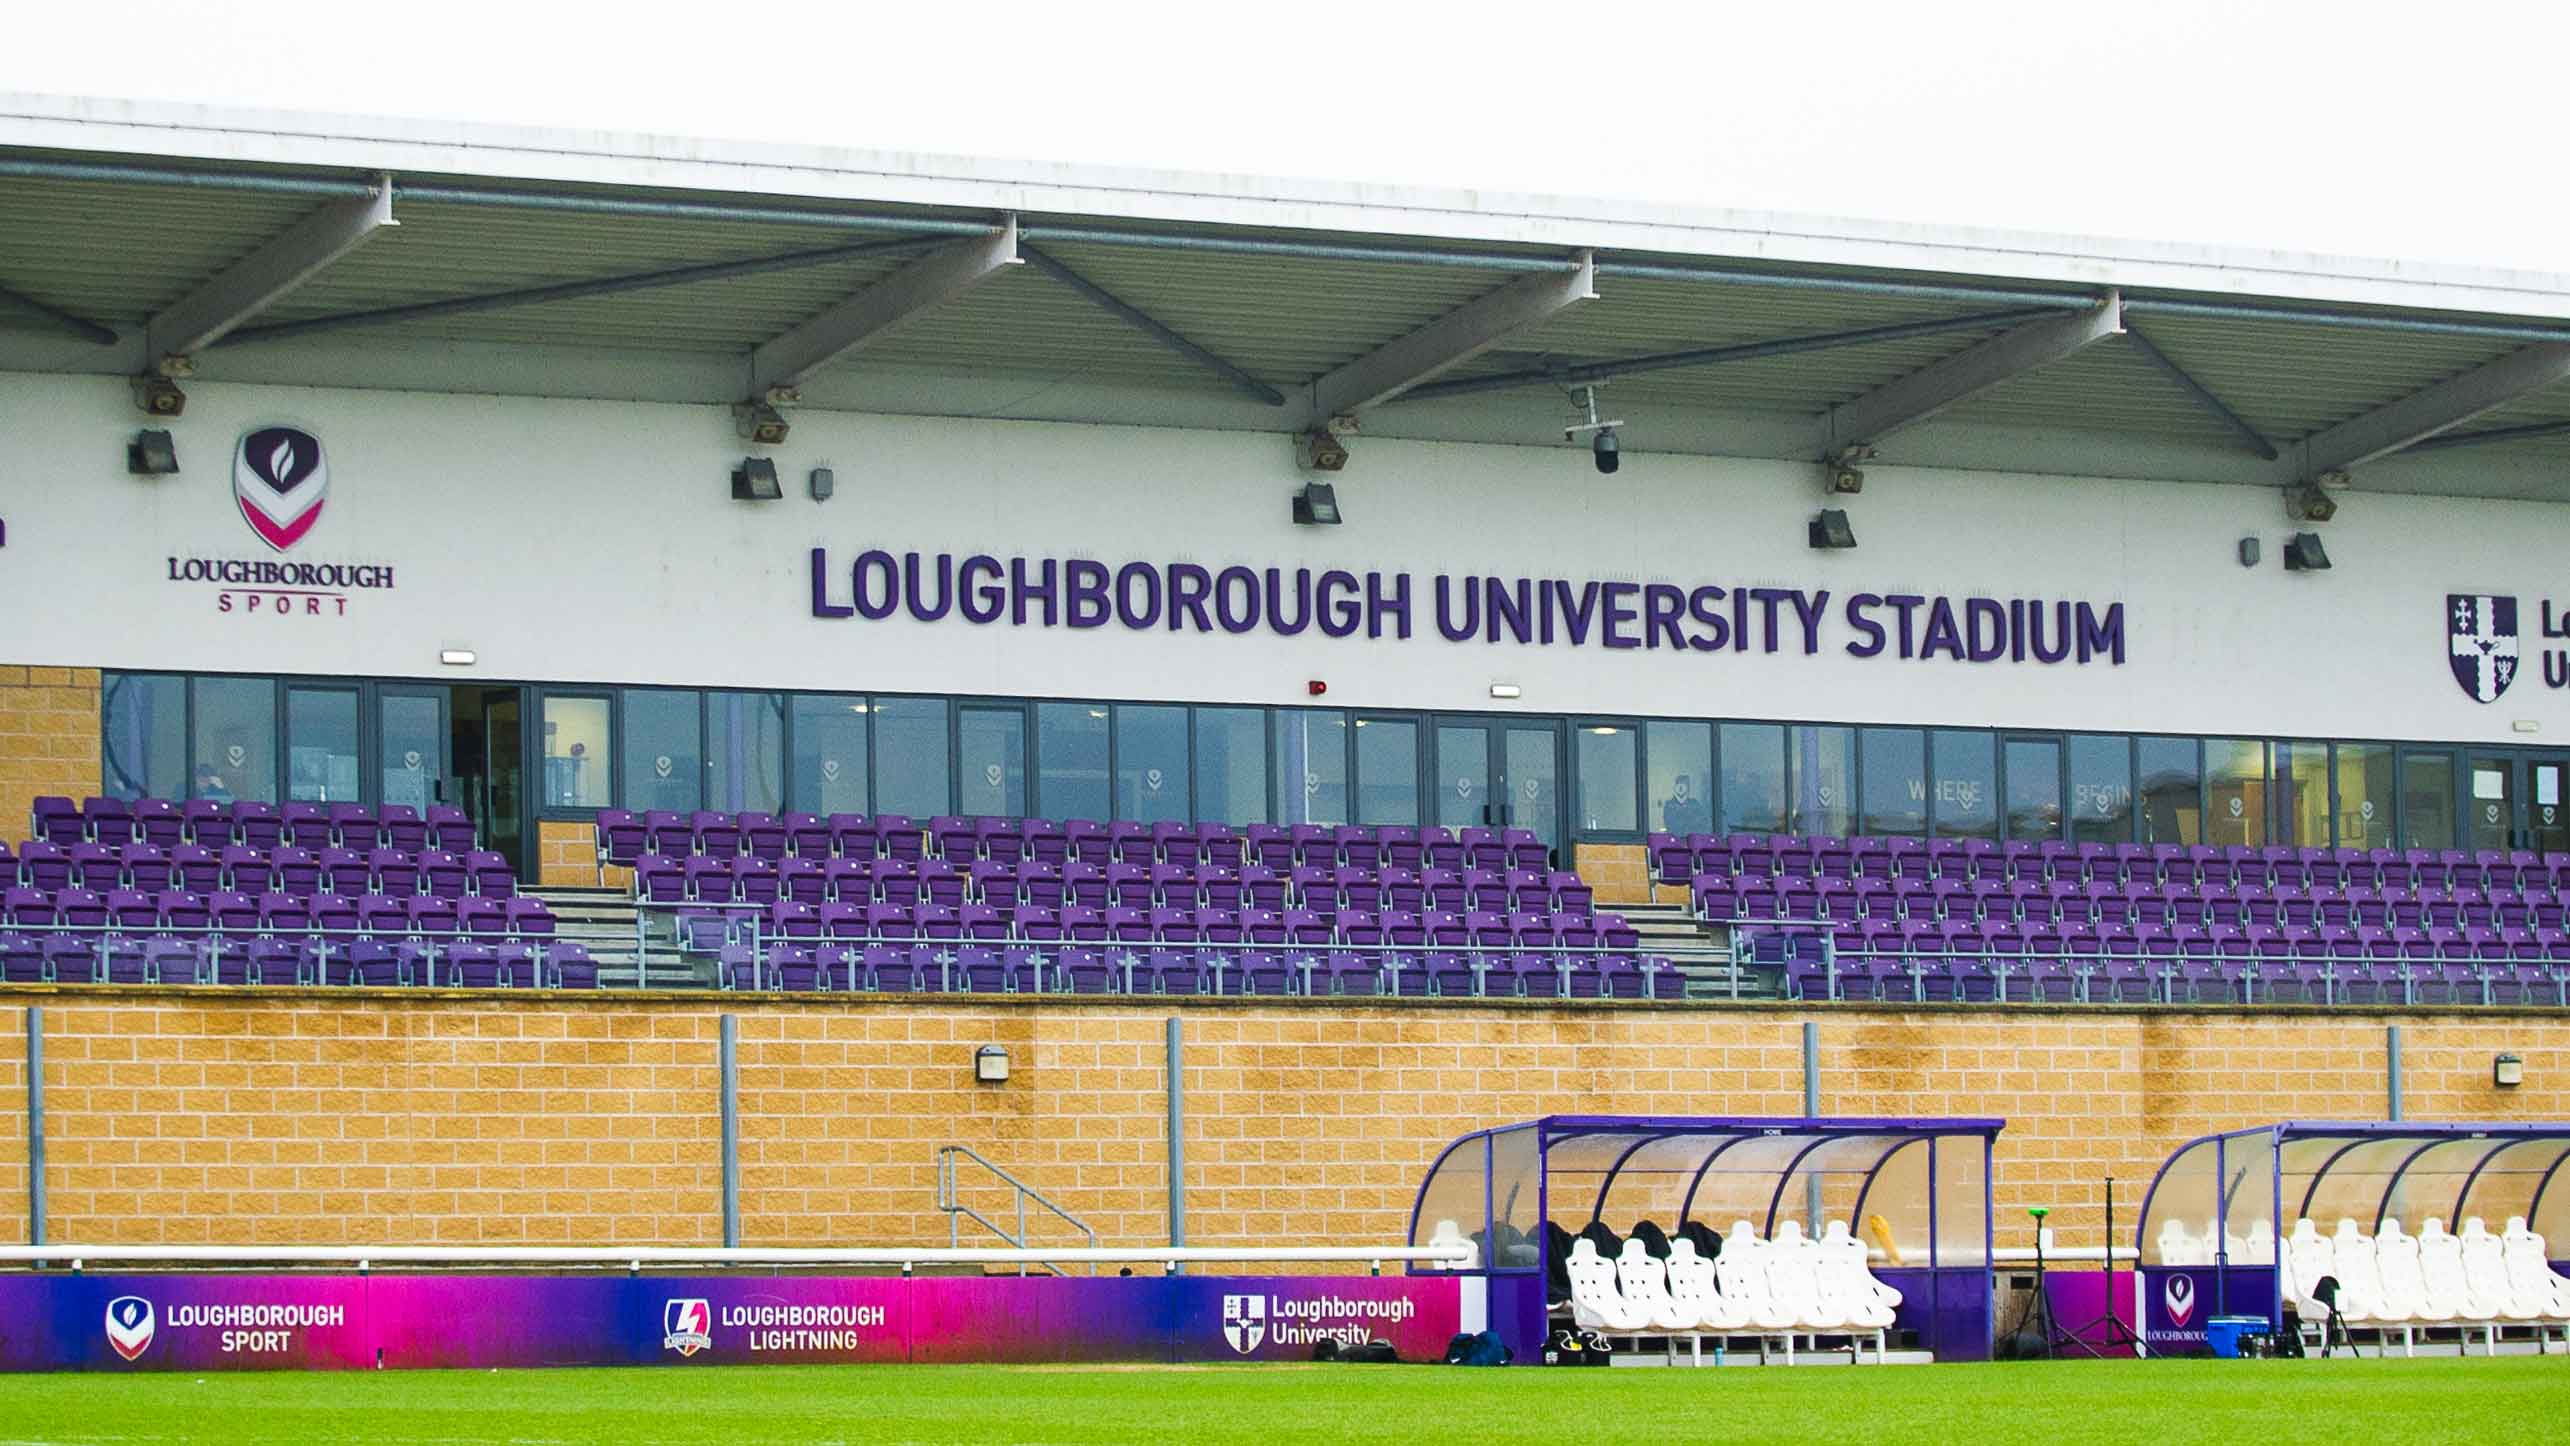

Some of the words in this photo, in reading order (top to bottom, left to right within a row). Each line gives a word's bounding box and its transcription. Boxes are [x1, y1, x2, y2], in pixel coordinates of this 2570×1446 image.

[167, 557, 394, 588] LOUGHBOROUGH
[218, 594, 348, 616] SPORT
[811, 547, 1411, 640] LOUGHBOROUGH
[1435, 574, 1830, 655] UNIVERSITY
[1845, 592, 2126, 665] STADIUM
[168, 1305, 344, 1326] LOUGHBOROUGH
[722, 1306, 885, 1326] LOUGHBOROUGH
[1272, 1295, 1414, 1323] Loughborough
[221, 1331, 291, 1352] SPORT
[750, 1330, 858, 1350] LIGHTNING
[1272, 1322, 1371, 1346] University
[2147, 1330, 2208, 1341] LOUGHBOROUG
